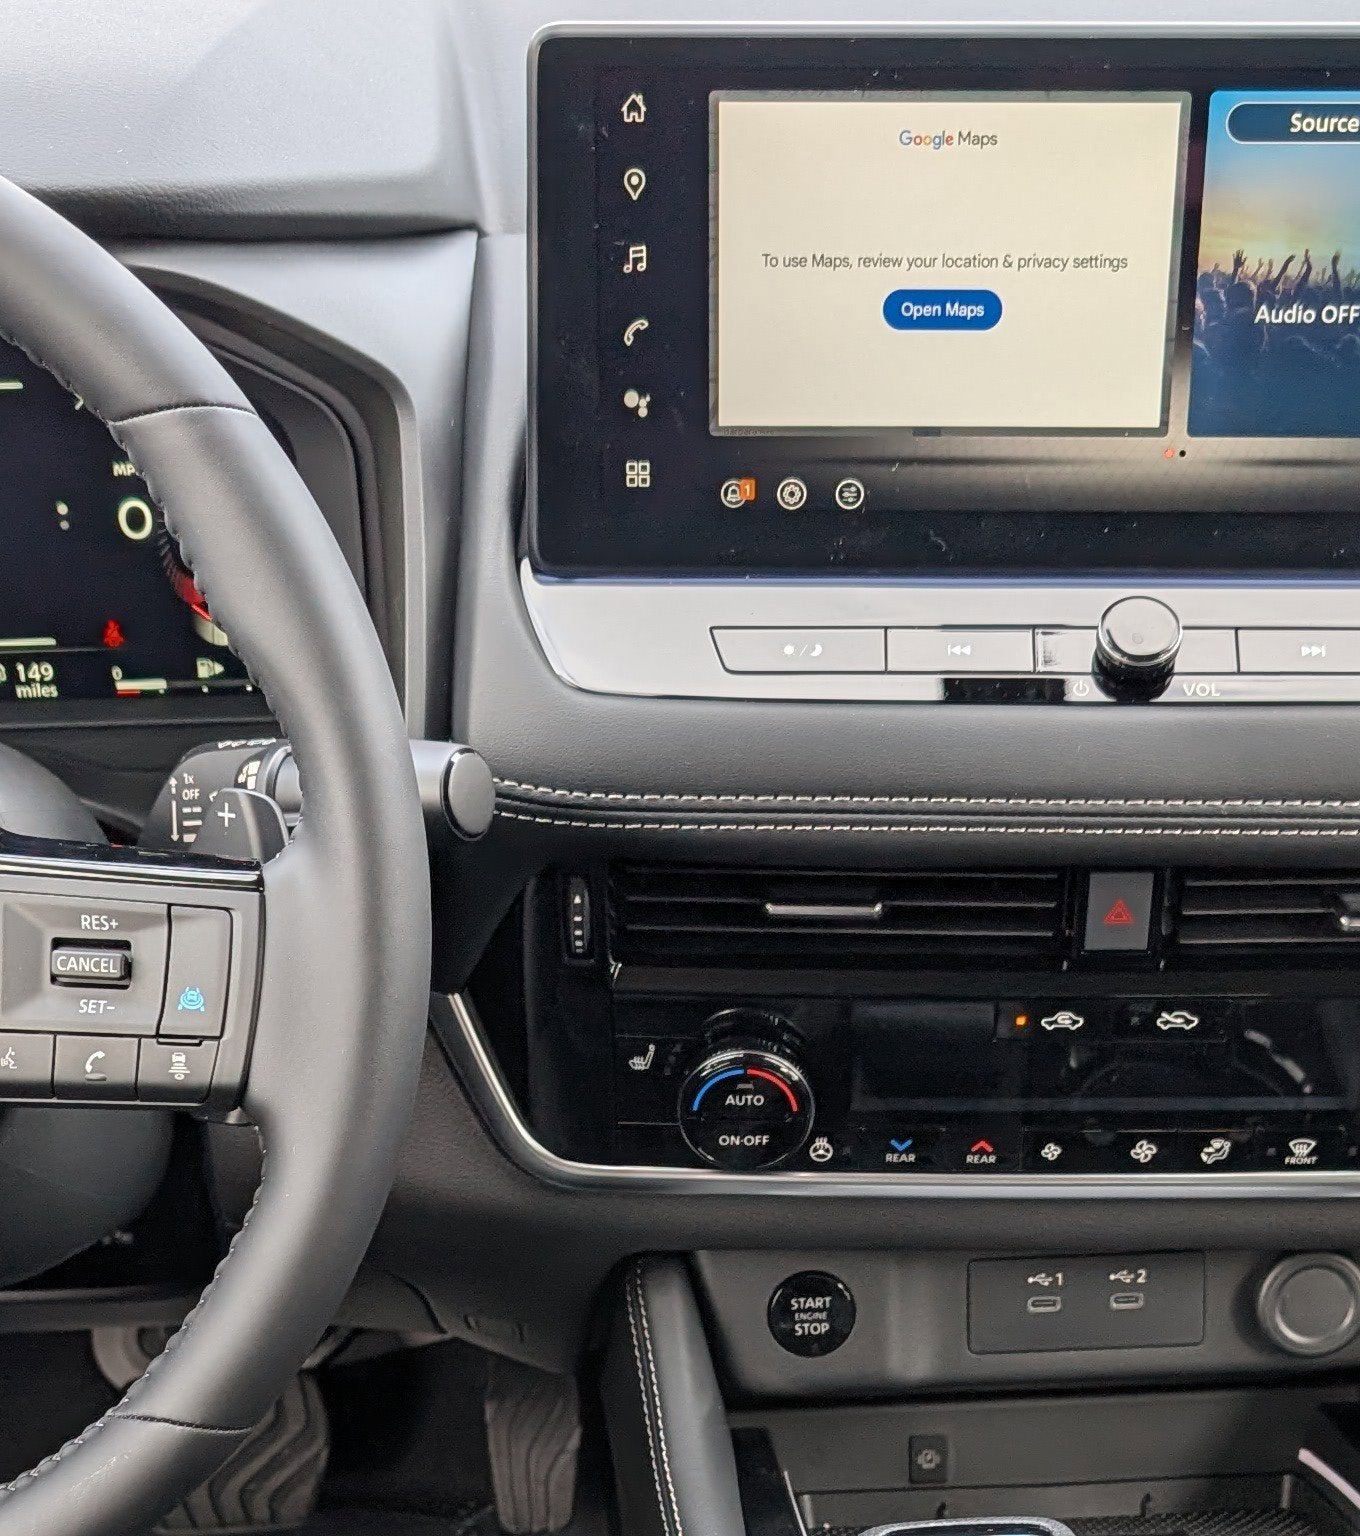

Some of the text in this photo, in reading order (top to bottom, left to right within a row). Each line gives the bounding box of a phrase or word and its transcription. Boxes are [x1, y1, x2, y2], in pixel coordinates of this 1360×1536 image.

[1289, 113, 1360, 134] Source
[899, 129, 998, 151] Google Maps
[762, 253, 1128, 272] To use Maps, review your location & privacy settings
[901, 301, 985, 319] Open Maps
[1254, 303, 1360, 325] Audio OFF
[744, 482, 752, 498] 1
[117, 497, 153, 541] 0
[16, 661, 54, 683] 149
[16, 683, 58, 699] miles
[1183, 682, 1221, 697] VOL
[182, 788, 201, 801] OFF
[80, 913, 119, 931] RES+
[56, 955, 118, 974] CANCEL
[725, 1094, 765, 1106] AUTO
[885, 1152, 916, 1164] REAR
[966, 1153, 996, 1165] REAR
[1283, 1155, 1319, 1166] FRONT
[1054, 1272, 1064, 1286] 1
[1136, 1269, 1147, 1284] 2
[790, 1295, 832, 1311] START
[794, 1311, 828, 1321] ENGINE
[793, 1321, 830, 1337] STOP
